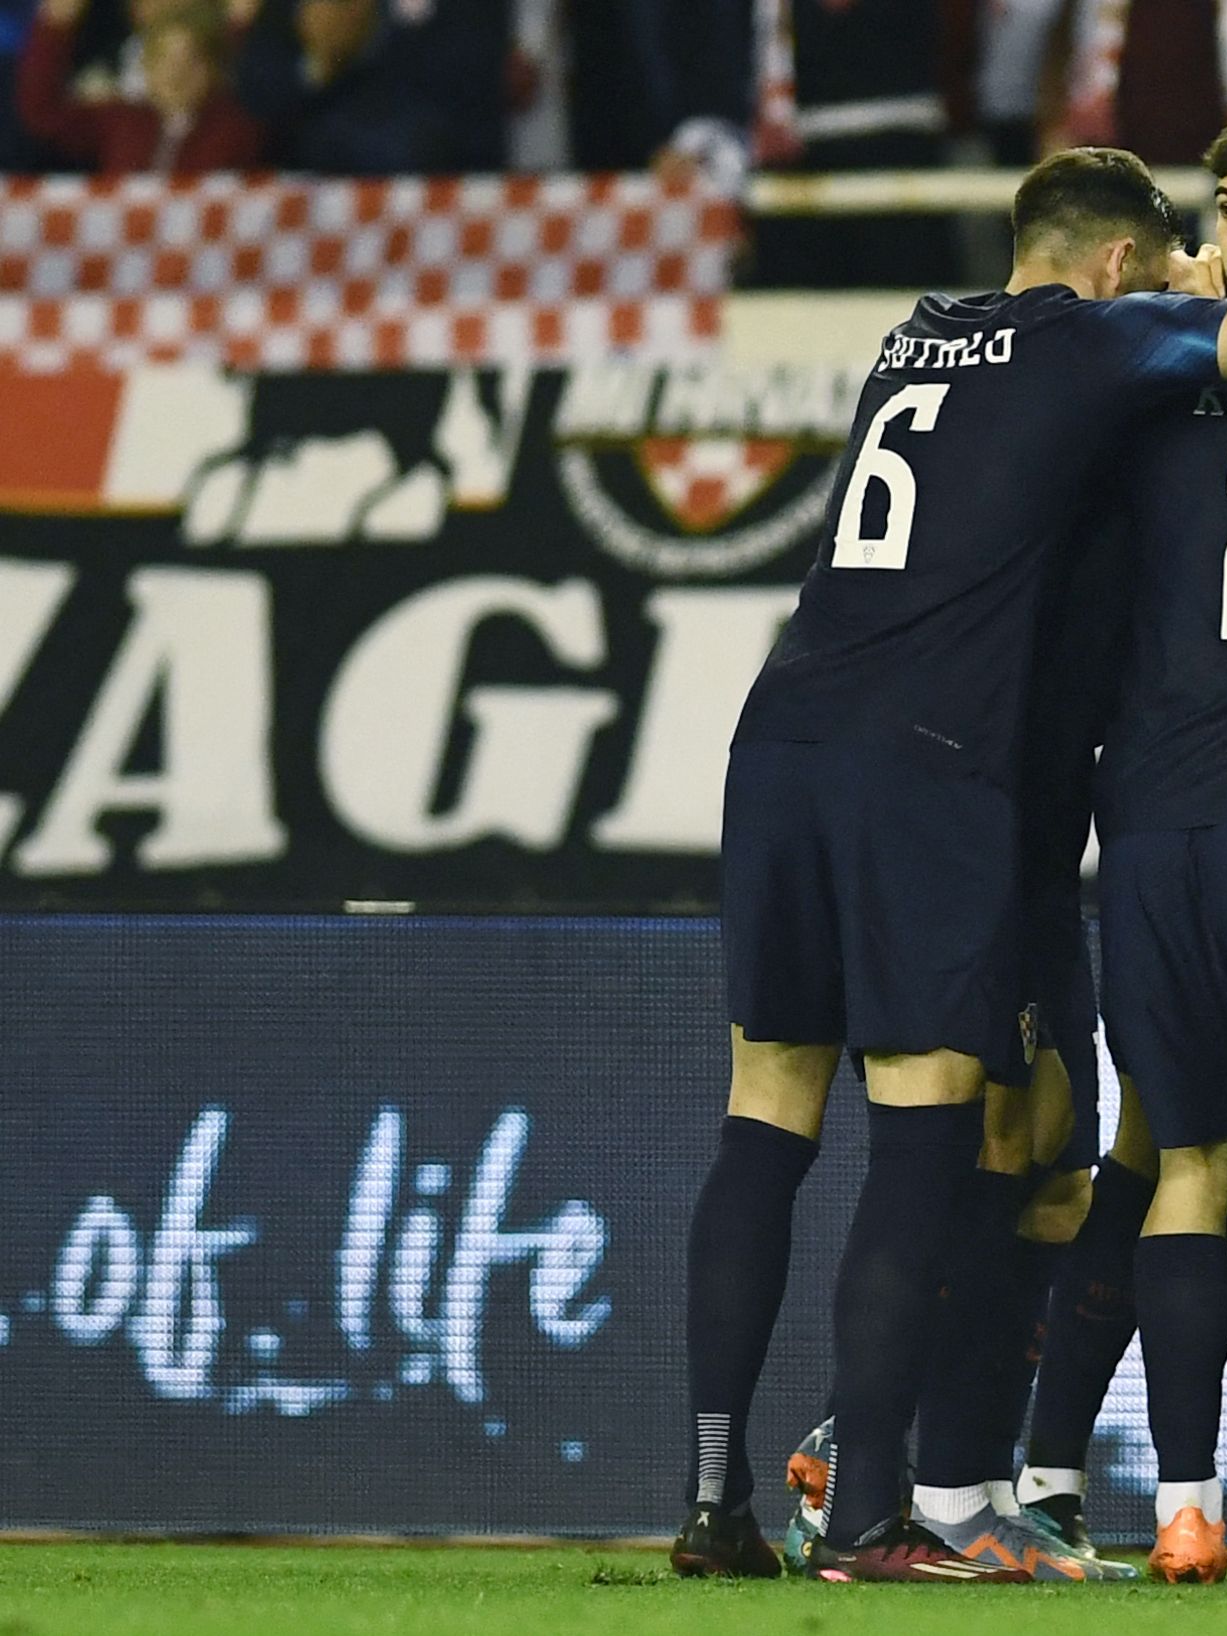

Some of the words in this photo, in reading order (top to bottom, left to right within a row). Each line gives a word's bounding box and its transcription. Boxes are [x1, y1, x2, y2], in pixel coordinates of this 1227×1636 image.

[831, 383, 951, 569] 6
[50, 1103, 260, 1400] of
[334, 1104, 612, 1402] life
